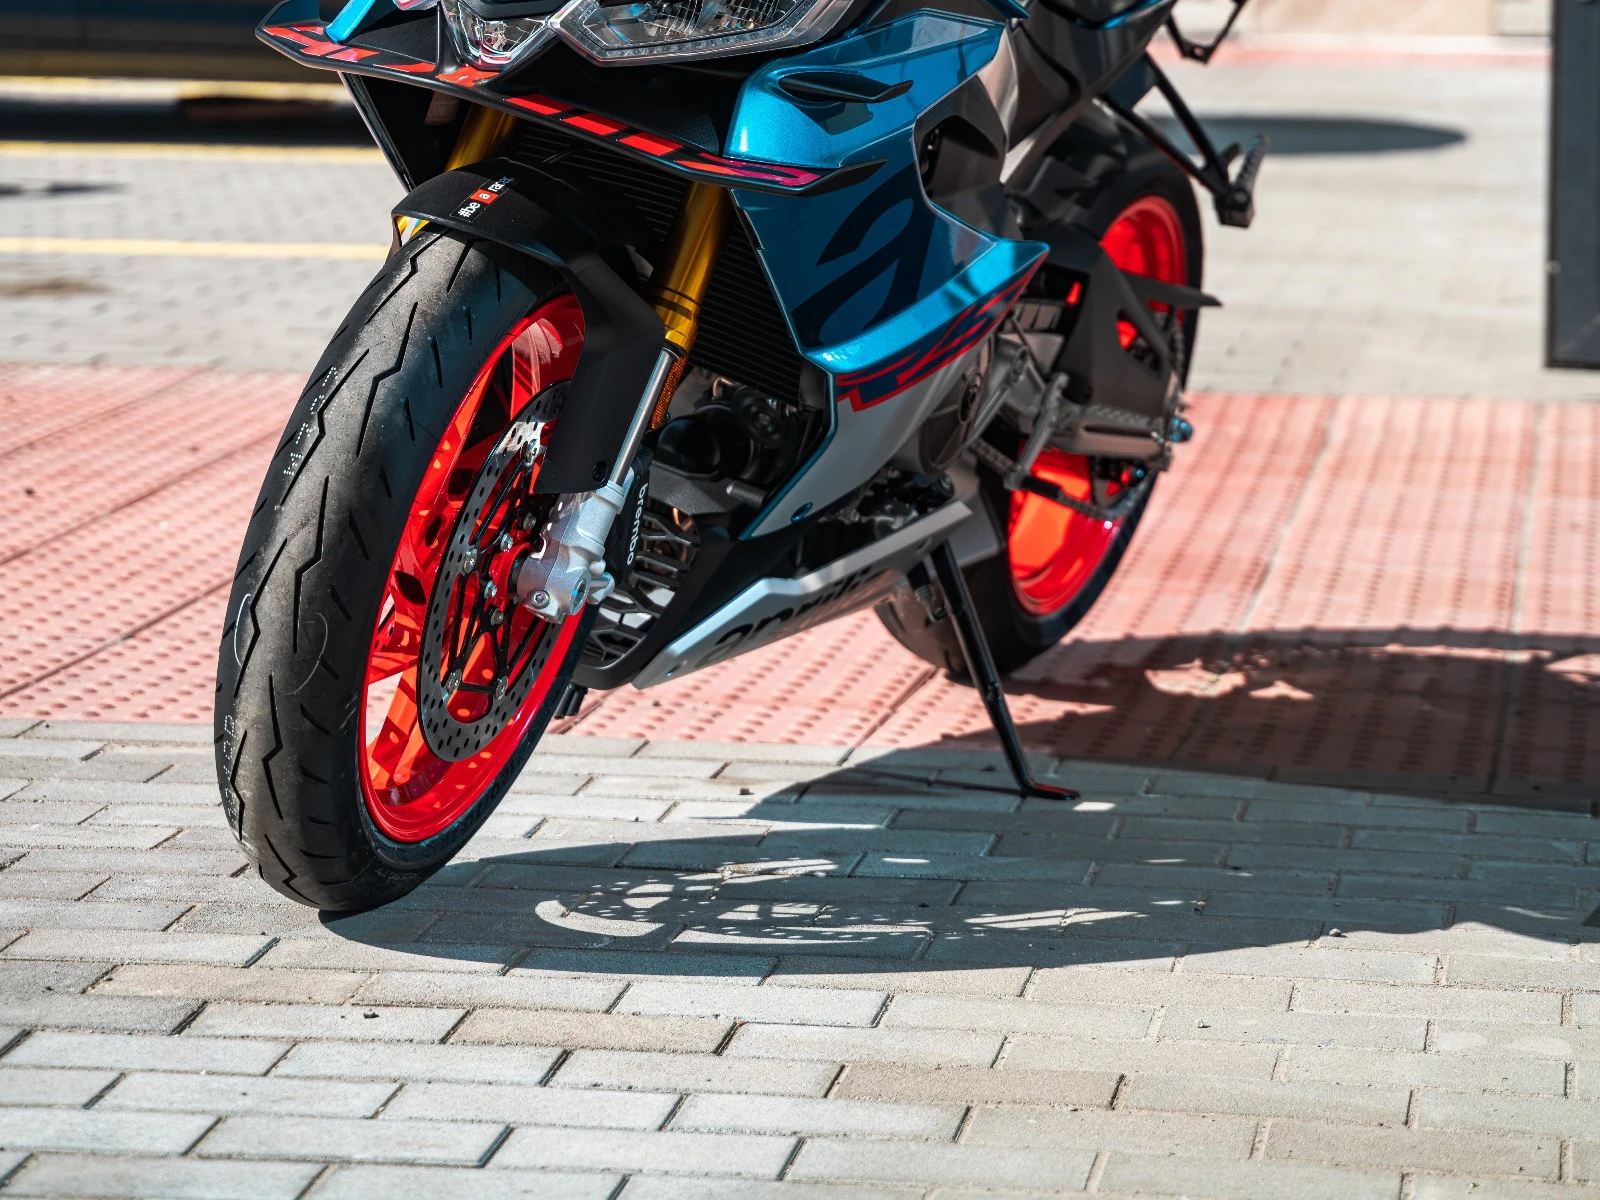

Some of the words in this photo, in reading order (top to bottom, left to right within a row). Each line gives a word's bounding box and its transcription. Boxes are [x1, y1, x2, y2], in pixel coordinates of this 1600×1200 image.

[457, 202, 481, 218] #be
[478, 192, 491, 200] a
[627, 482, 649, 566] brembo
